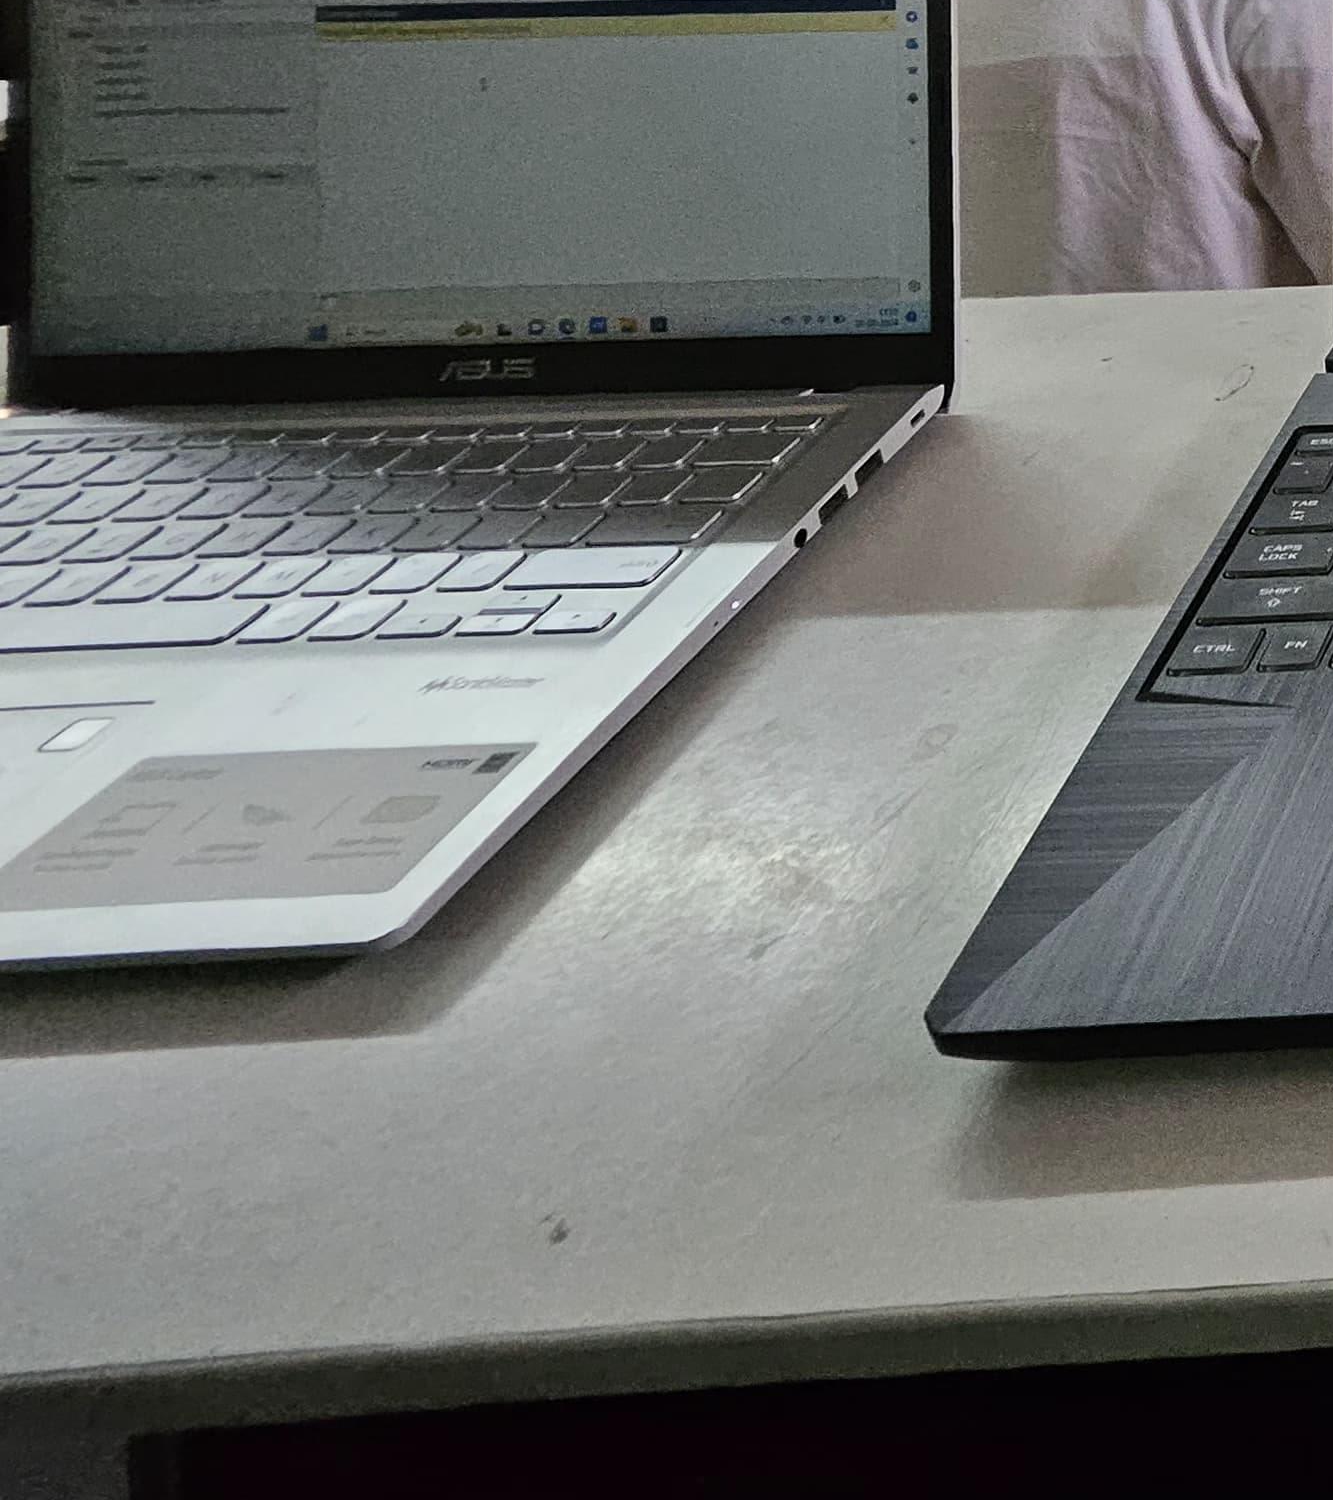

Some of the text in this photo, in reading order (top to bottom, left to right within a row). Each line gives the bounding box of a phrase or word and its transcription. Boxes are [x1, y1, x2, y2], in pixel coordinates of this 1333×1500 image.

[1263, 544, 1303, 553] CAPS
[1258, 552, 1300, 562] LOCK
[1258, 586, 1304, 596] SHIFT
[1193, 644, 1236, 654] CTRL
[1284, 639, 1308, 650] FN
